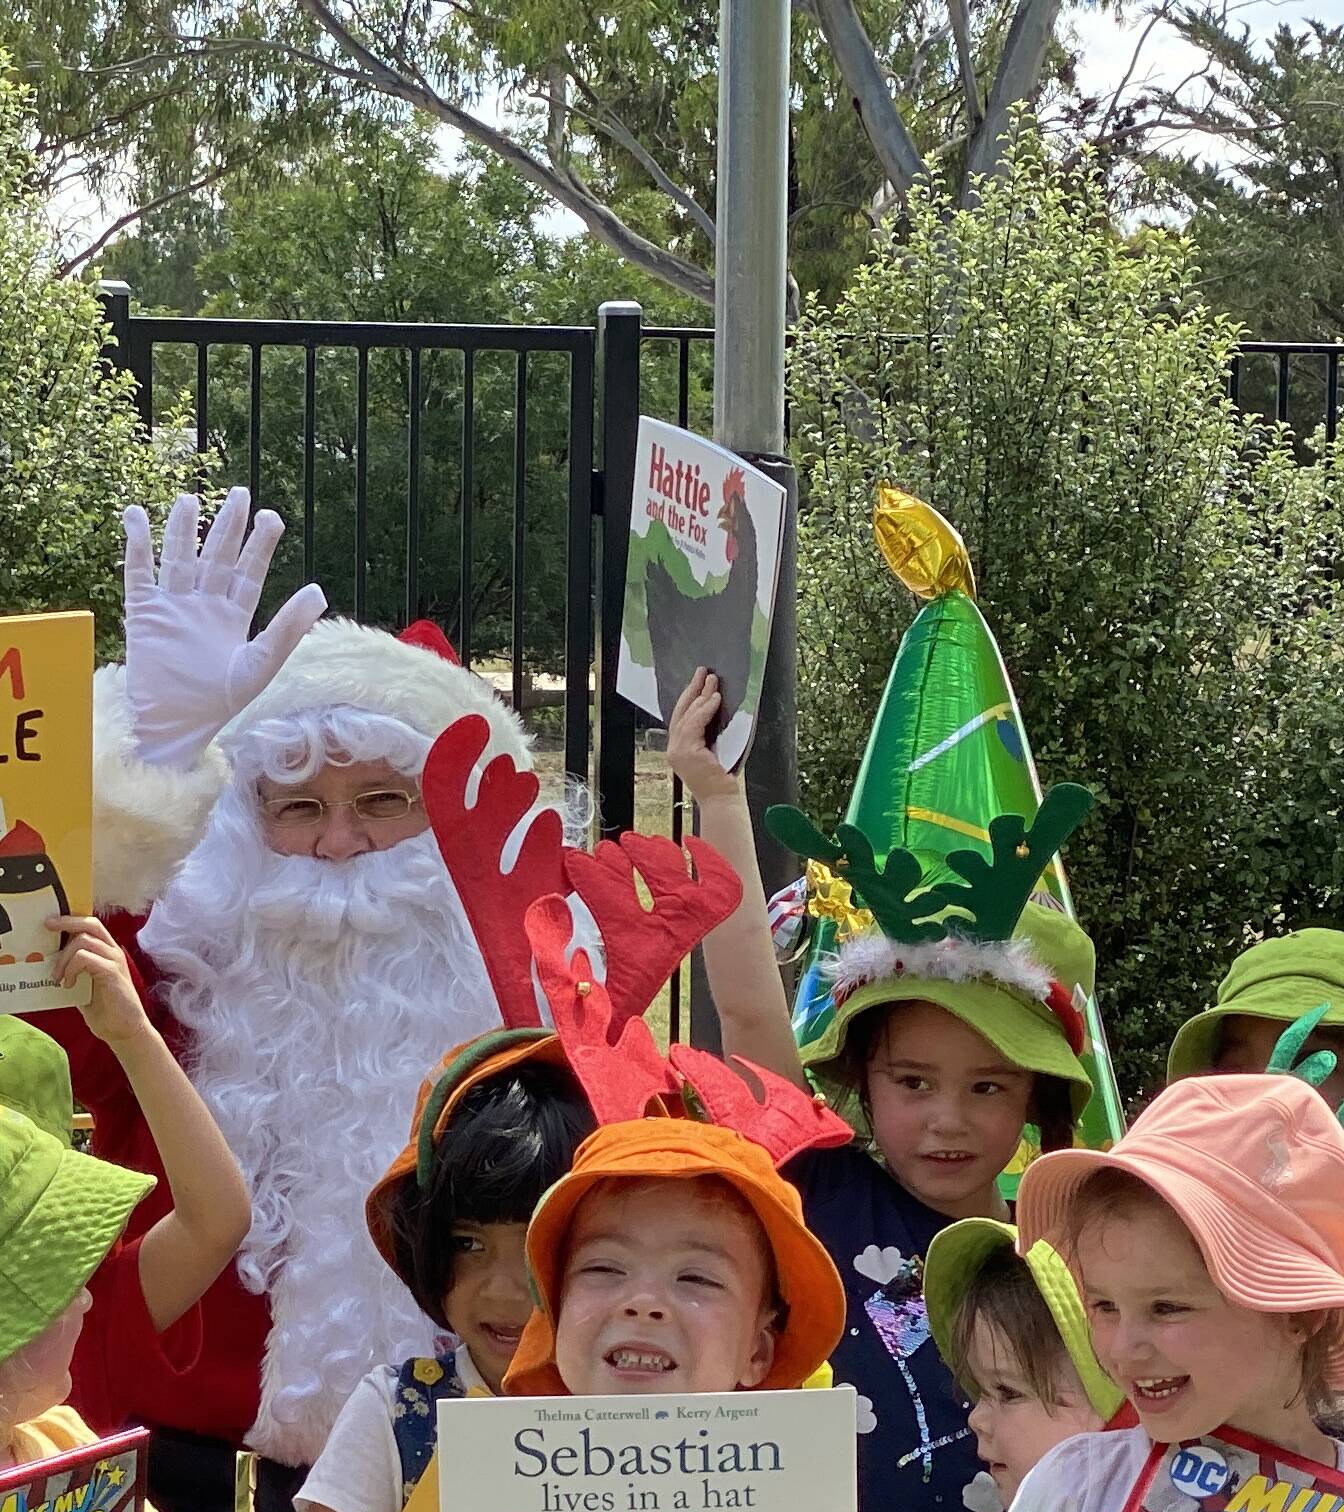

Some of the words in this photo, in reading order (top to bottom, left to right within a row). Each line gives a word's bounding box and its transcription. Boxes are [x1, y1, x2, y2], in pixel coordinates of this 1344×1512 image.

[649, 443, 710, 517] Hattie
[646, 498, 665, 521] and
[668, 505, 685, 534] the
[688, 513, 708, 546] Fox
[535, 1408, 581, 1422] Thelma
[584, 1407, 650, 1422] Catterwell
[676, 1406, 711, 1422] Kerry
[714, 1405, 759, 1422] Argent
[513, 1427, 784, 1479] Sebastian
[1173, 1448, 1227, 1493] DC
[541, 1483, 615, 1512] lives
[627, 1483, 660, 1511] in
[671, 1488, 690, 1509] a
[701, 1479, 757, 1508] hat
